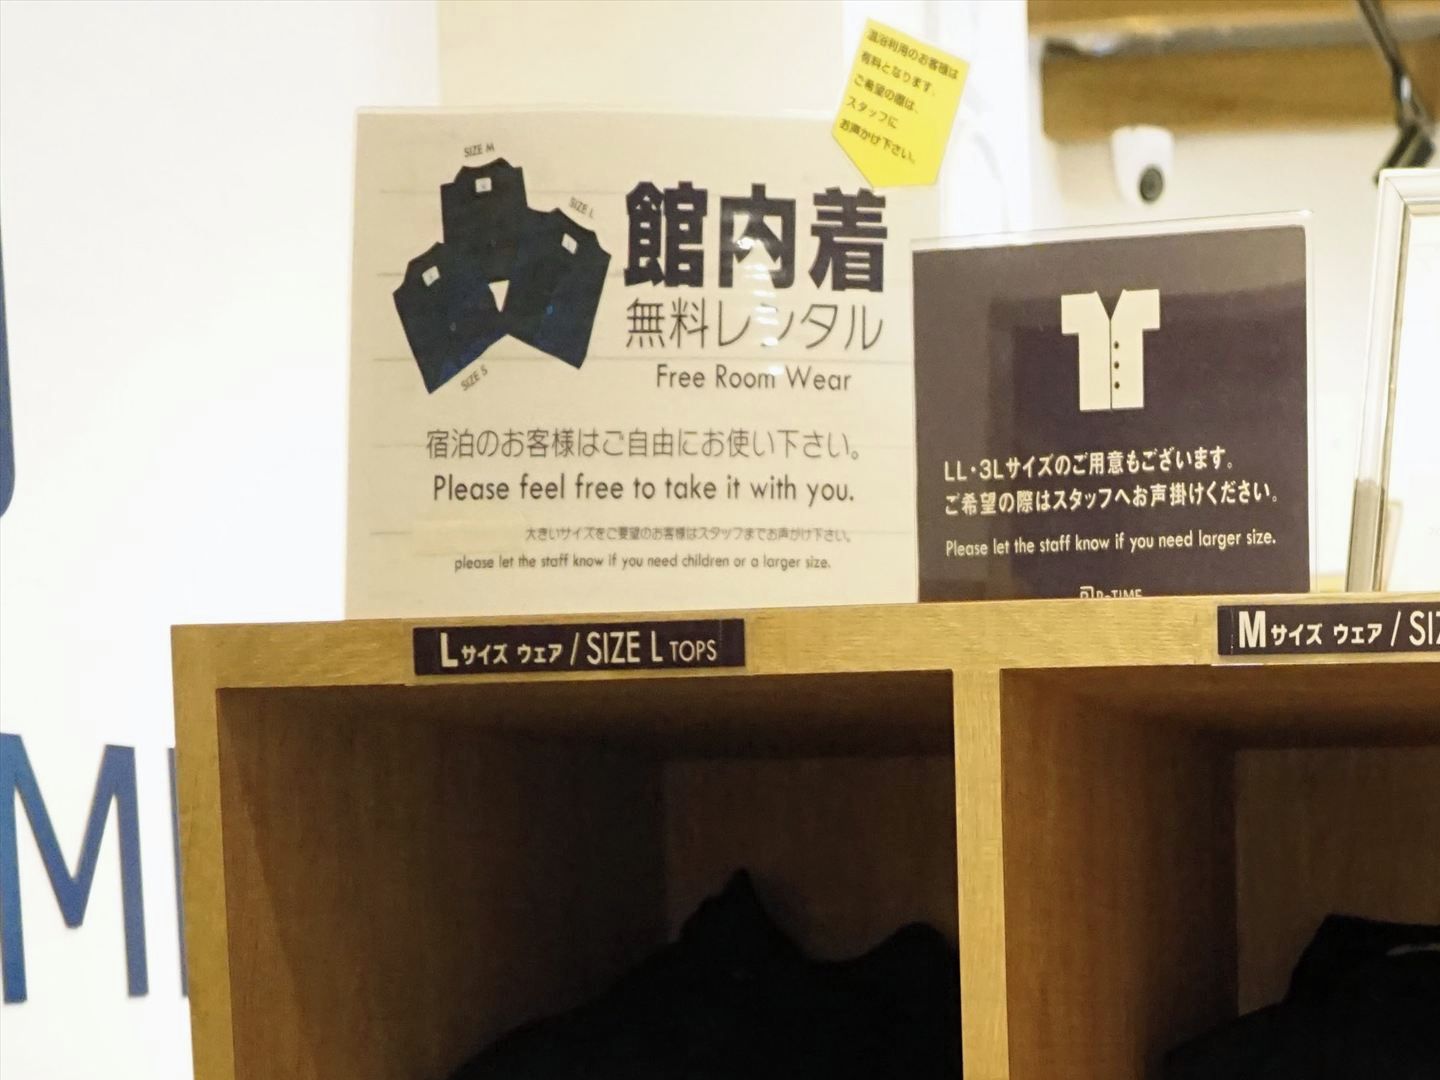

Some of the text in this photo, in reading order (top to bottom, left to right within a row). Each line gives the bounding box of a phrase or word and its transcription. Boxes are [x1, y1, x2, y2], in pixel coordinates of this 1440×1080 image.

[846, 96, 899, 129] スタッフに
[464, 143, 495, 157] SIZE M
[569, 197, 594, 219] SIZE L
[623, 180, 888, 292] 館内着
[626, 297, 883, 351] 無料レンタル
[460, 364, 488, 392] SIZE S
[656, 363, 851, 391] Free Room Wear
[426, 427, 859, 460] 宿泊のお客様はご自由にお使い下さい。
[433, 472, 854, 508] Please feel free to take it with you.
[945, 479, 1277, 516] ご希望の際はスタッフへお声掛けください。
[945, 528, 1277, 557] Please let the staff know if you need larger size.
[455, 553, 832, 573] please let the staff know if you need children or a larger size.
[517, 643, 563, 664] ウェア
[586, 631, 641, 665] SIZE
[651, 630, 663, 663] L
[669, 638, 718, 662] TOPS
[1333, 623, 1383, 645] ウェア
